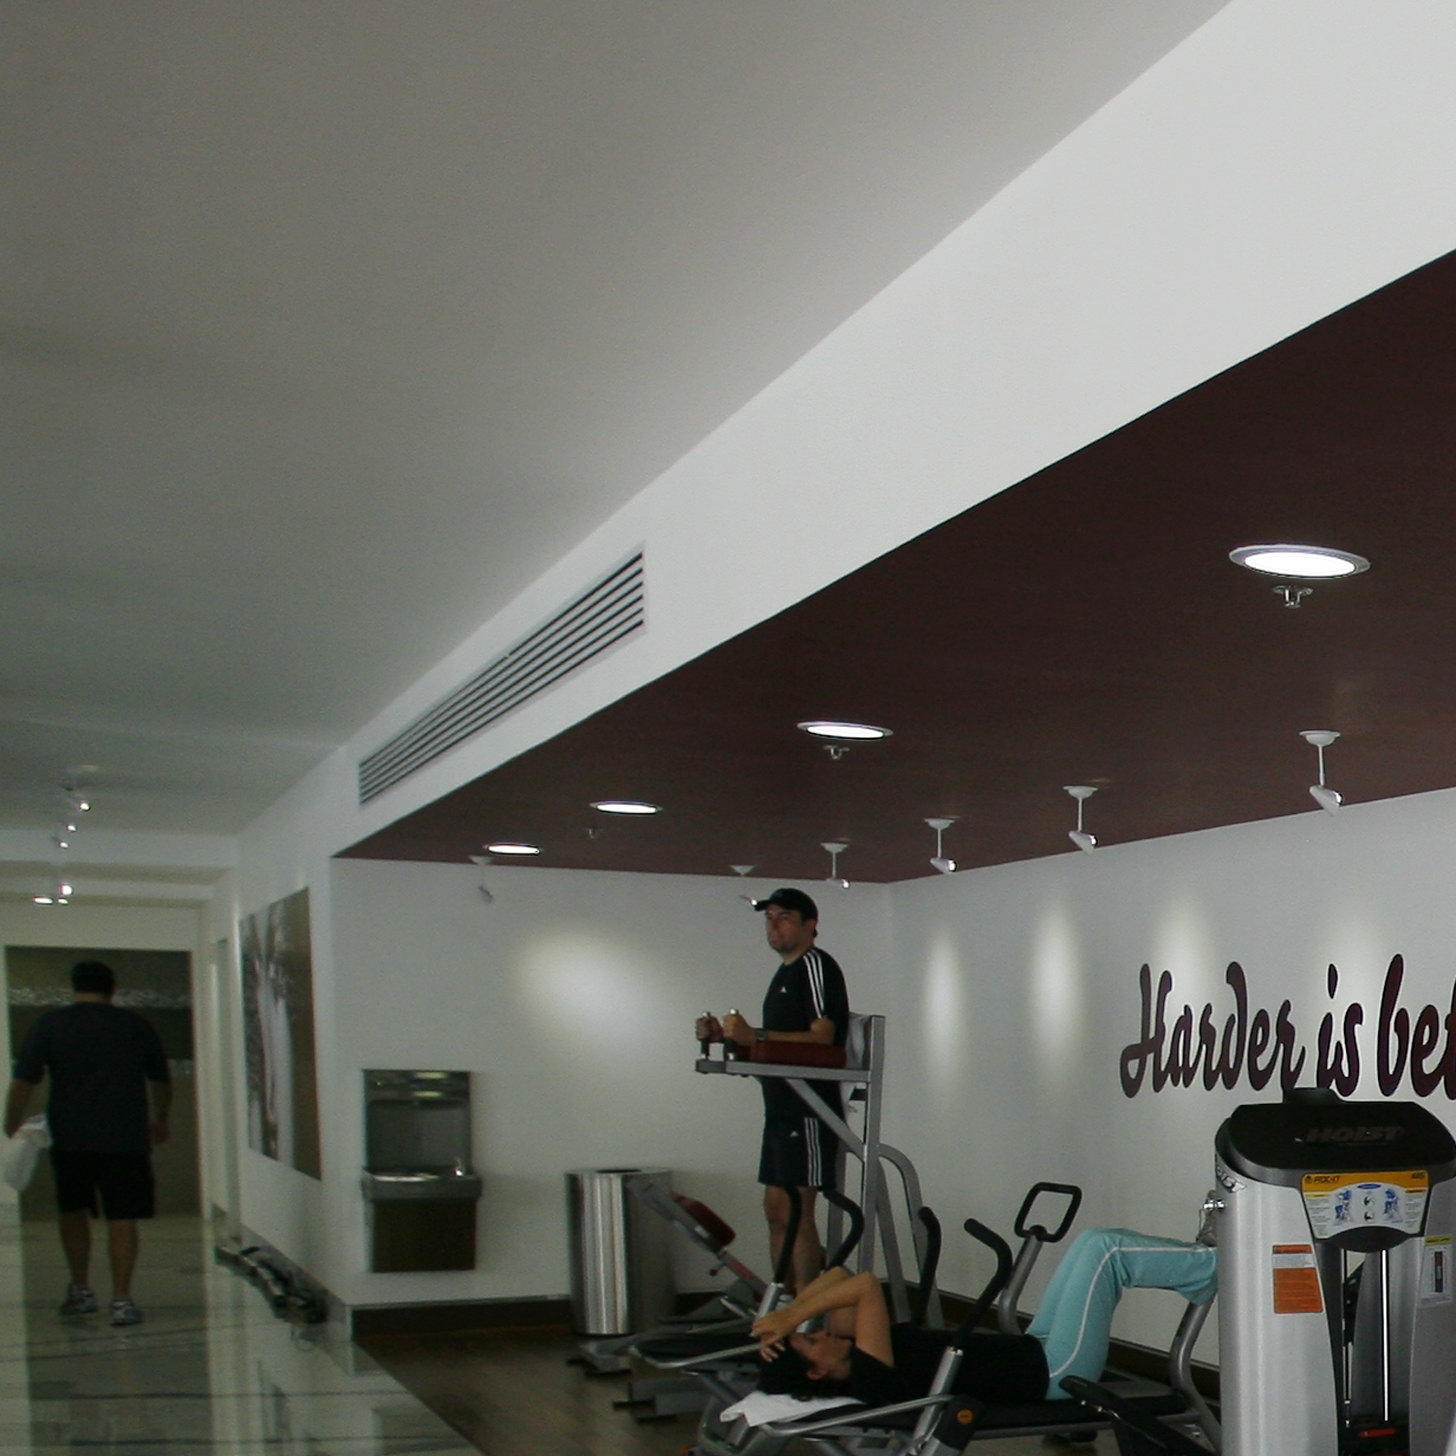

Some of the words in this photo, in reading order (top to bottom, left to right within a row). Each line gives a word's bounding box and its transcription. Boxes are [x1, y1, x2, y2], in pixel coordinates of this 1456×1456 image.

[1120, 961, 1305, 1098] Harder
[1317, 963, 1363, 1097] is
[1305, 1126, 1406, 1143] HOIST
